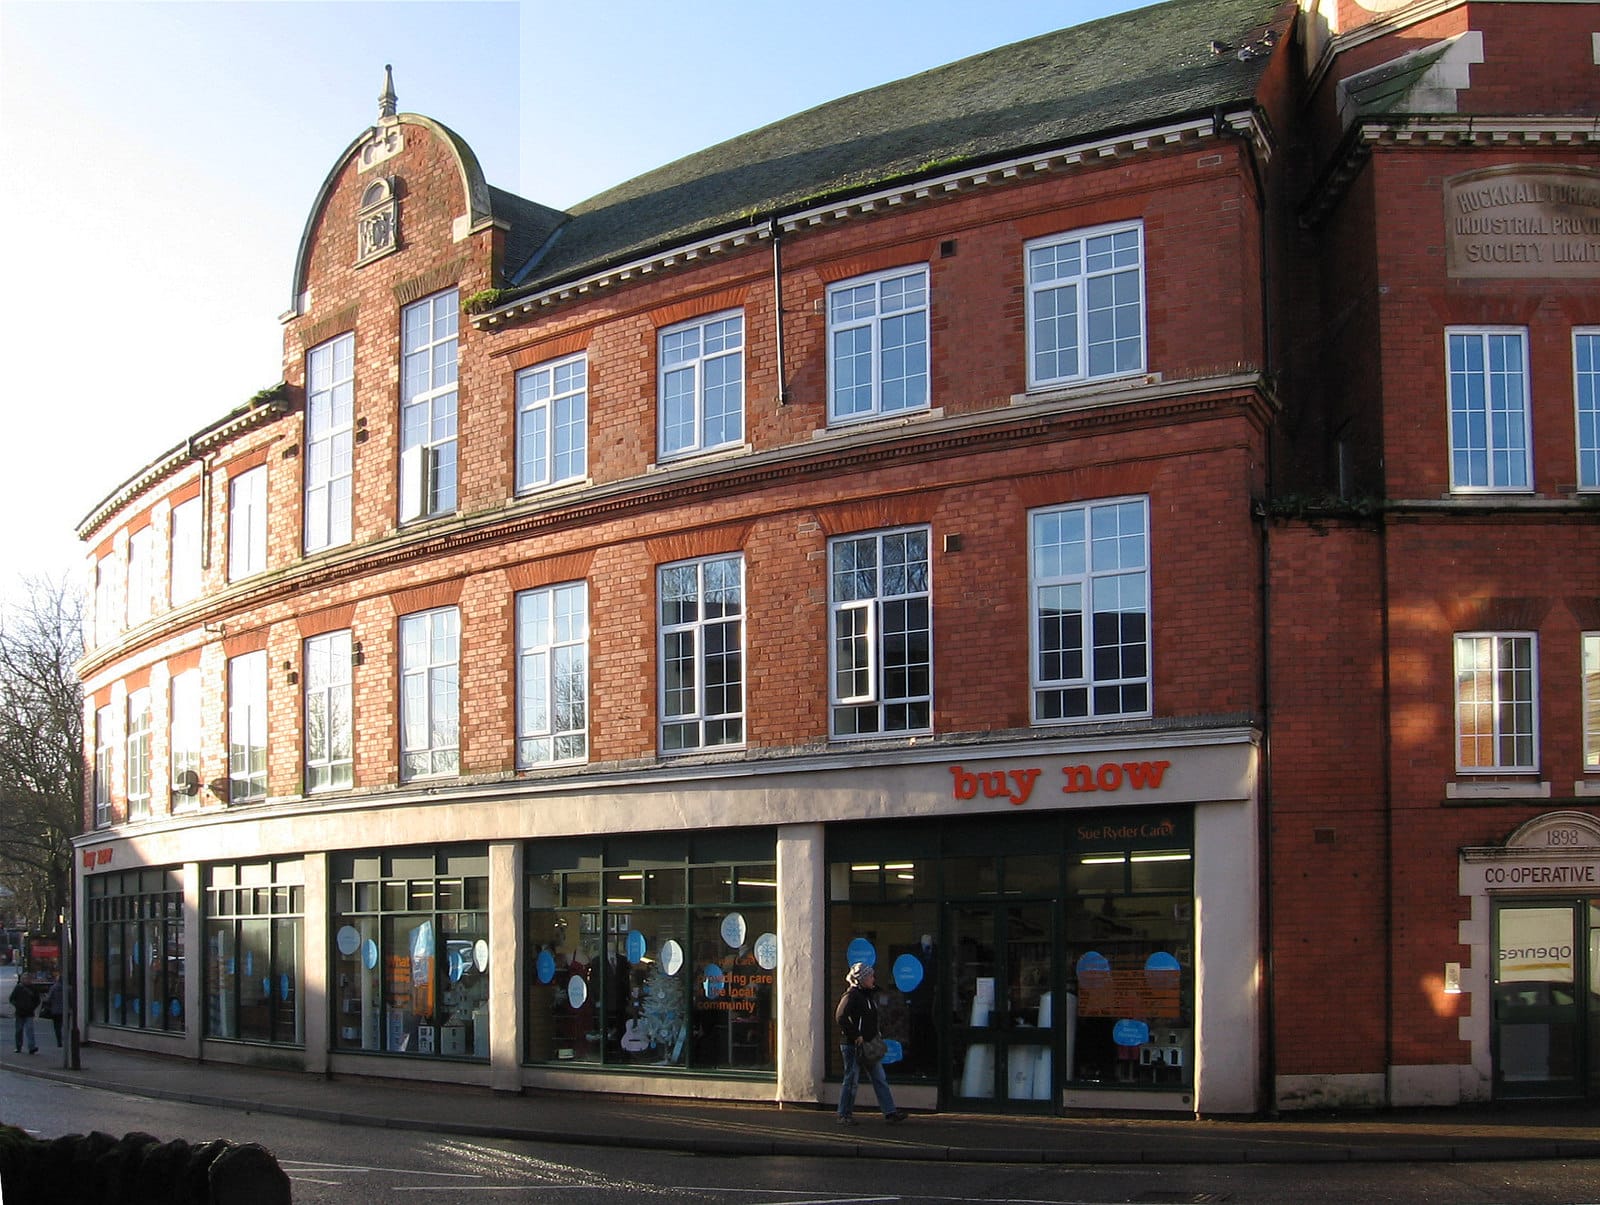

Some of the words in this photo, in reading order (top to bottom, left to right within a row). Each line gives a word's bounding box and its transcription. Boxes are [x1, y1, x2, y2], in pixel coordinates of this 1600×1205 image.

[1457, 183, 1544, 214] HUCKNALL
[1456, 216, 1548, 236] INDUSTRIAL
[1552, 216, 1600, 236] PROVI
[1466, 242, 1545, 262] SOCIETY
[950, 765, 1041, 805] buy
[1062, 760, 1170, 793] now
[1077, 826, 1101, 840] Sue
[1104, 824, 1138, 840] Ryder
[1141, 820, 1173, 838] Care
[1547, 830, 1578, 845] 1898
[1485, 866, 1595, 883] CO-OPERATIVE
[749, 974, 773, 984] care
[729, 986, 755, 997] local
[697, 1000, 756, 1013] community
